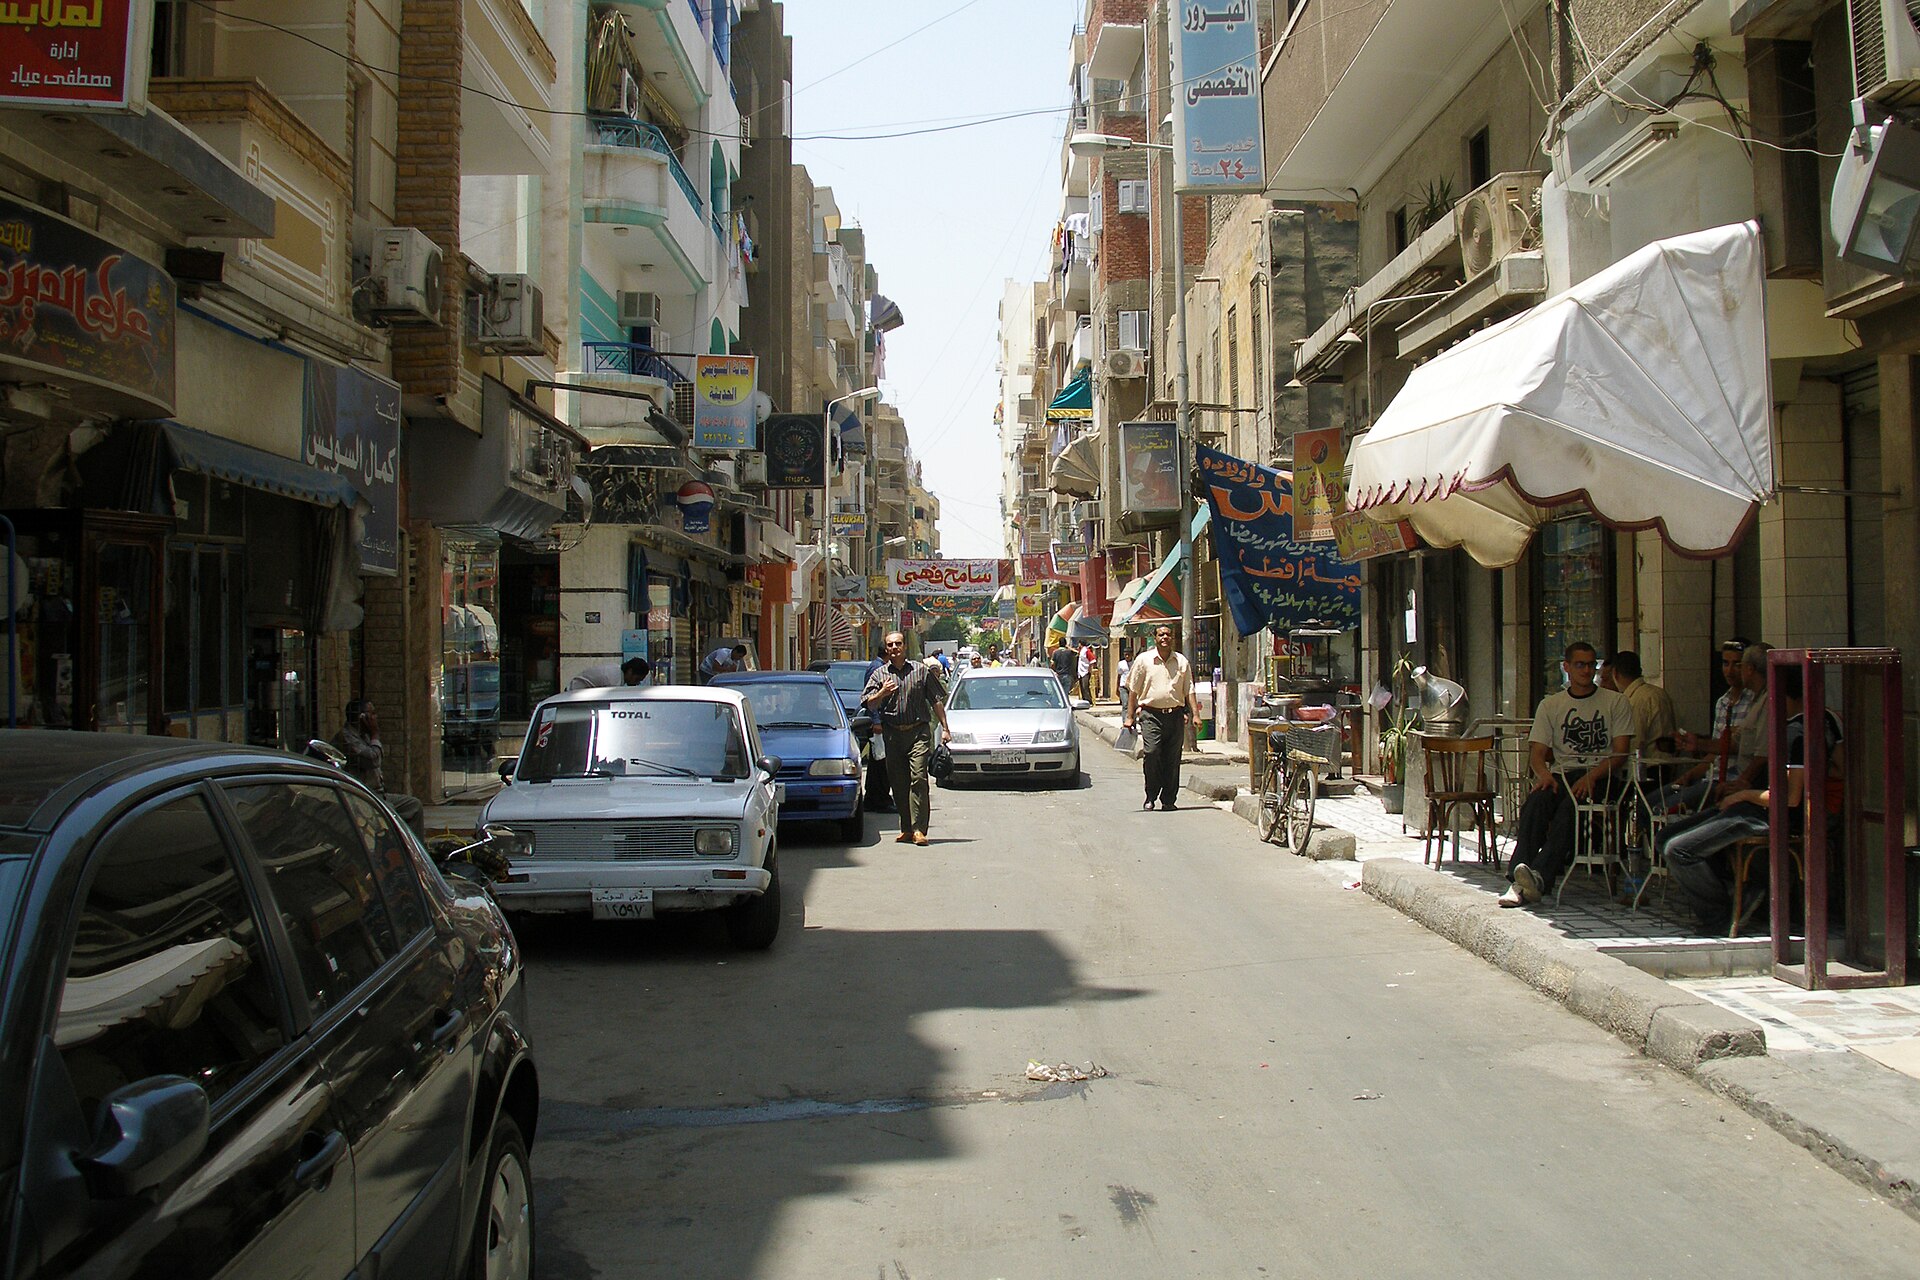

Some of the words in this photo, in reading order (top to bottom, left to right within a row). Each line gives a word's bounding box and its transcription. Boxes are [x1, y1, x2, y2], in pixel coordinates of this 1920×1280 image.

[1184, 0, 1252, 31] الفيروز
[50, 41, 79, 61] إدارة
[10, 64, 40, 87] عياد
[44, 67, 112, 88] مصطفى
[1187, 65, 1255, 106] التخصصى
[1192, 136, 1257, 152] خدمة
[364, 439, 396, 487] كمال
[833, 515, 864, 524] ELKURSAL
[896, 564, 943, 586] فهمى
[944, 563, 992, 590] سامح
[1304, 556, 1361, 590] جبة
[611, 711, 651, 720] TOTAL
